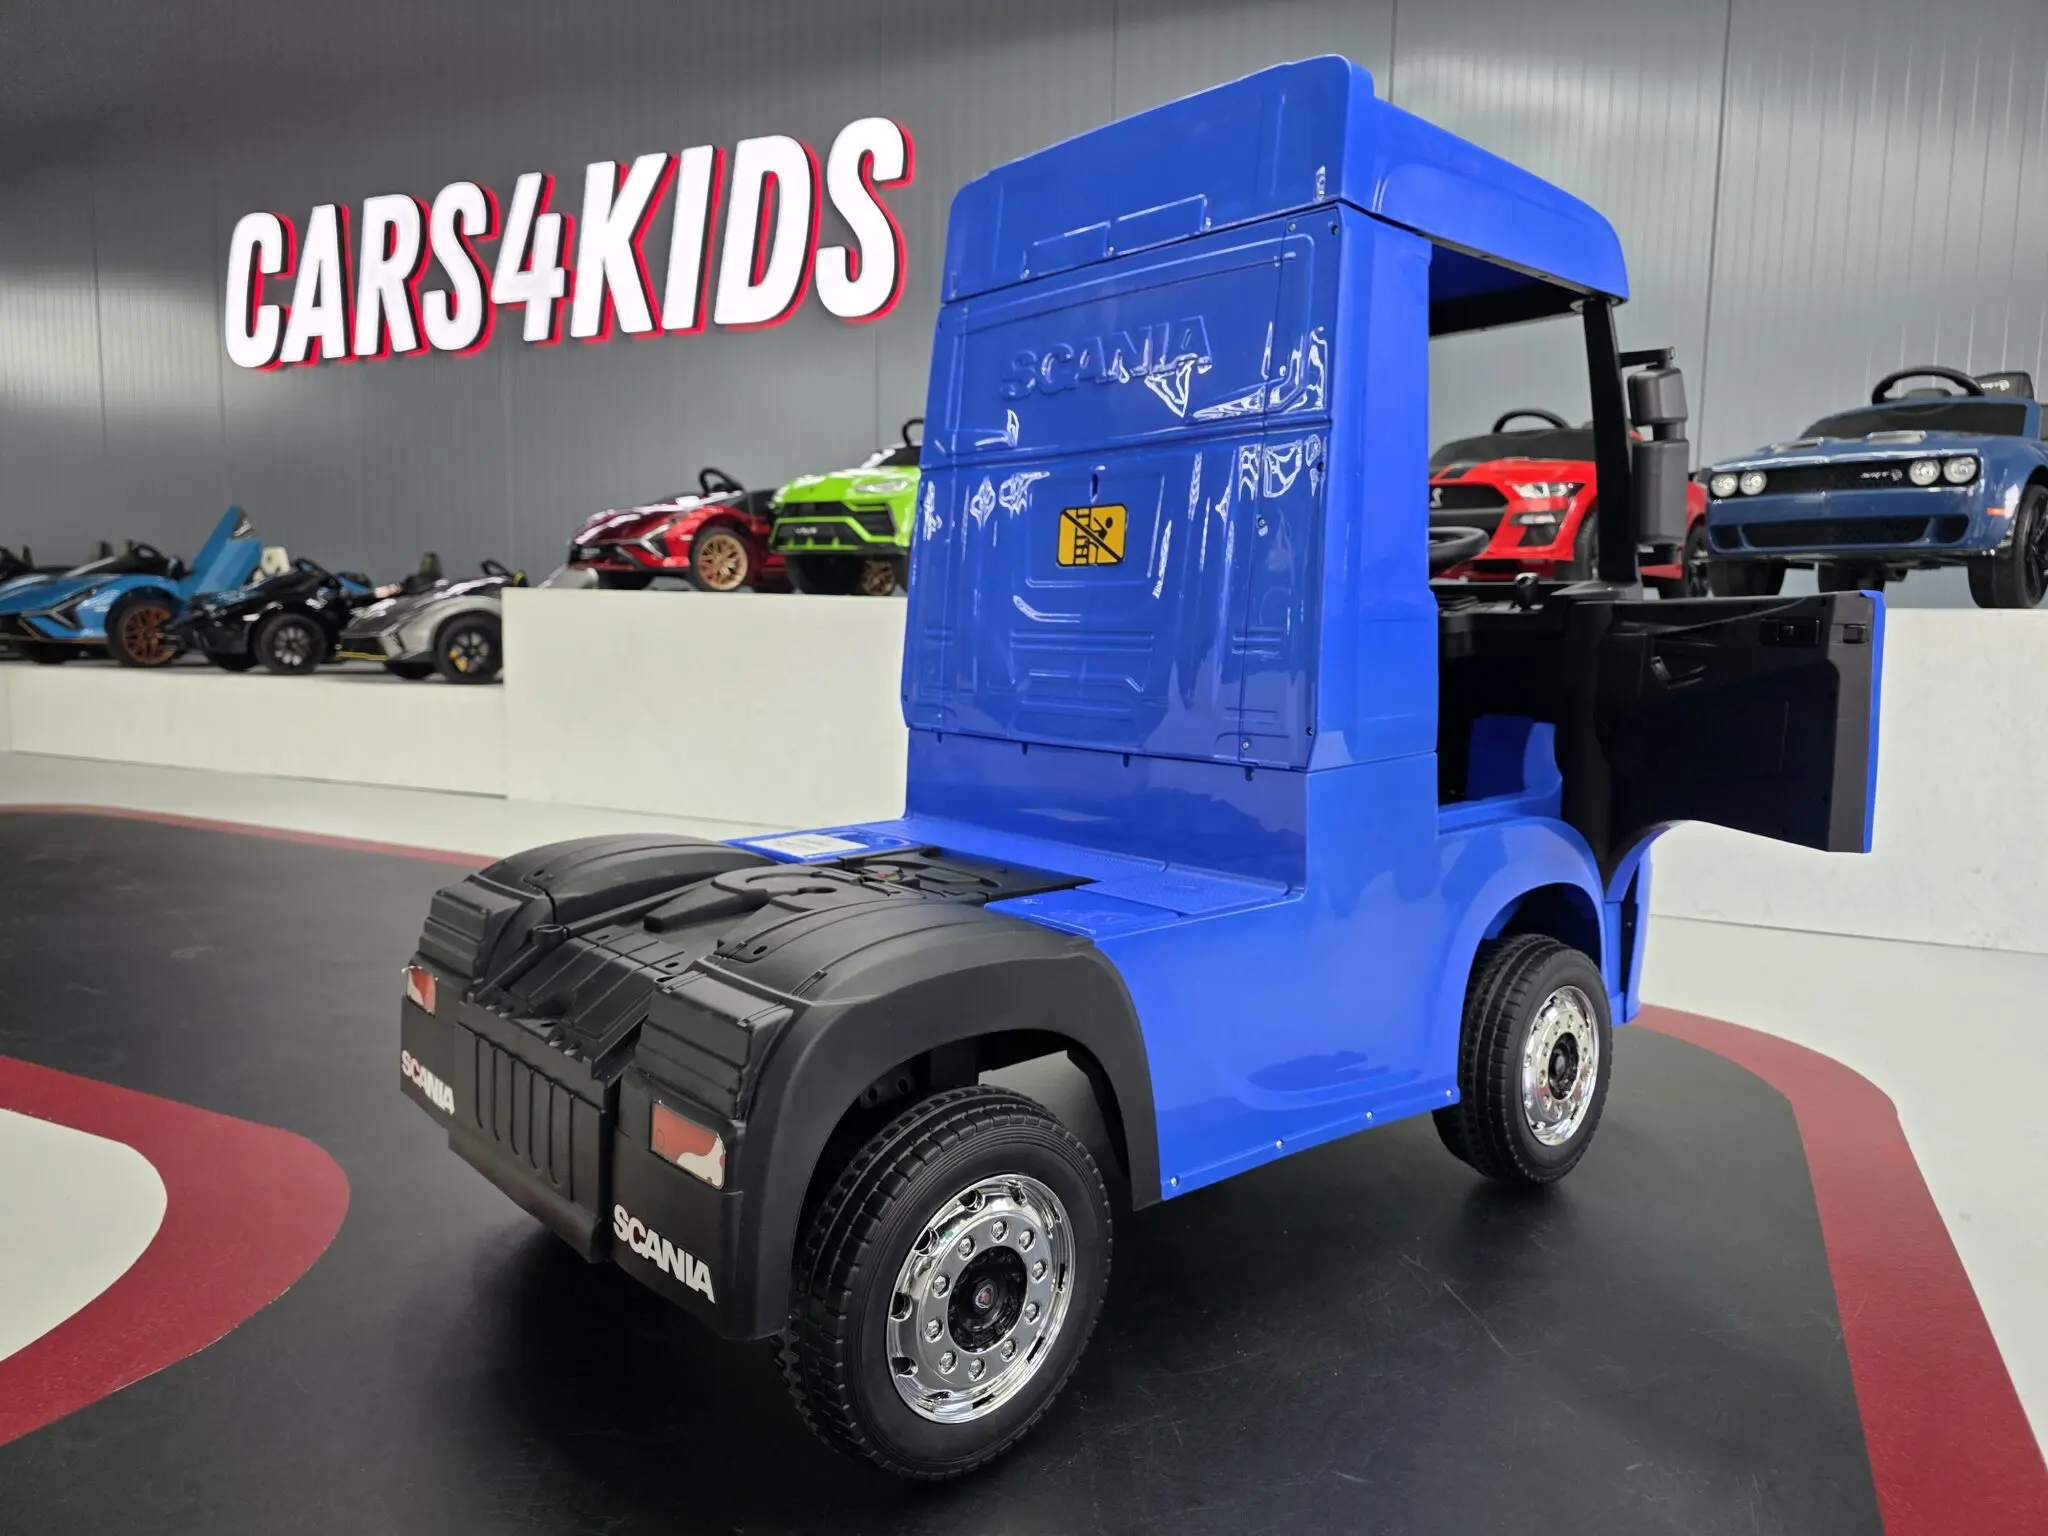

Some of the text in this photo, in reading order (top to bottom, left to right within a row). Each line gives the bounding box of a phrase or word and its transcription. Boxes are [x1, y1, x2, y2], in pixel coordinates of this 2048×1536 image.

[225, 116, 908, 369] CARS4KIDS
[1000, 315, 1213, 400] SCANIA
[402, 1049, 455, 1115] SCANIA
[613, 1204, 716, 1304] SCANIA
